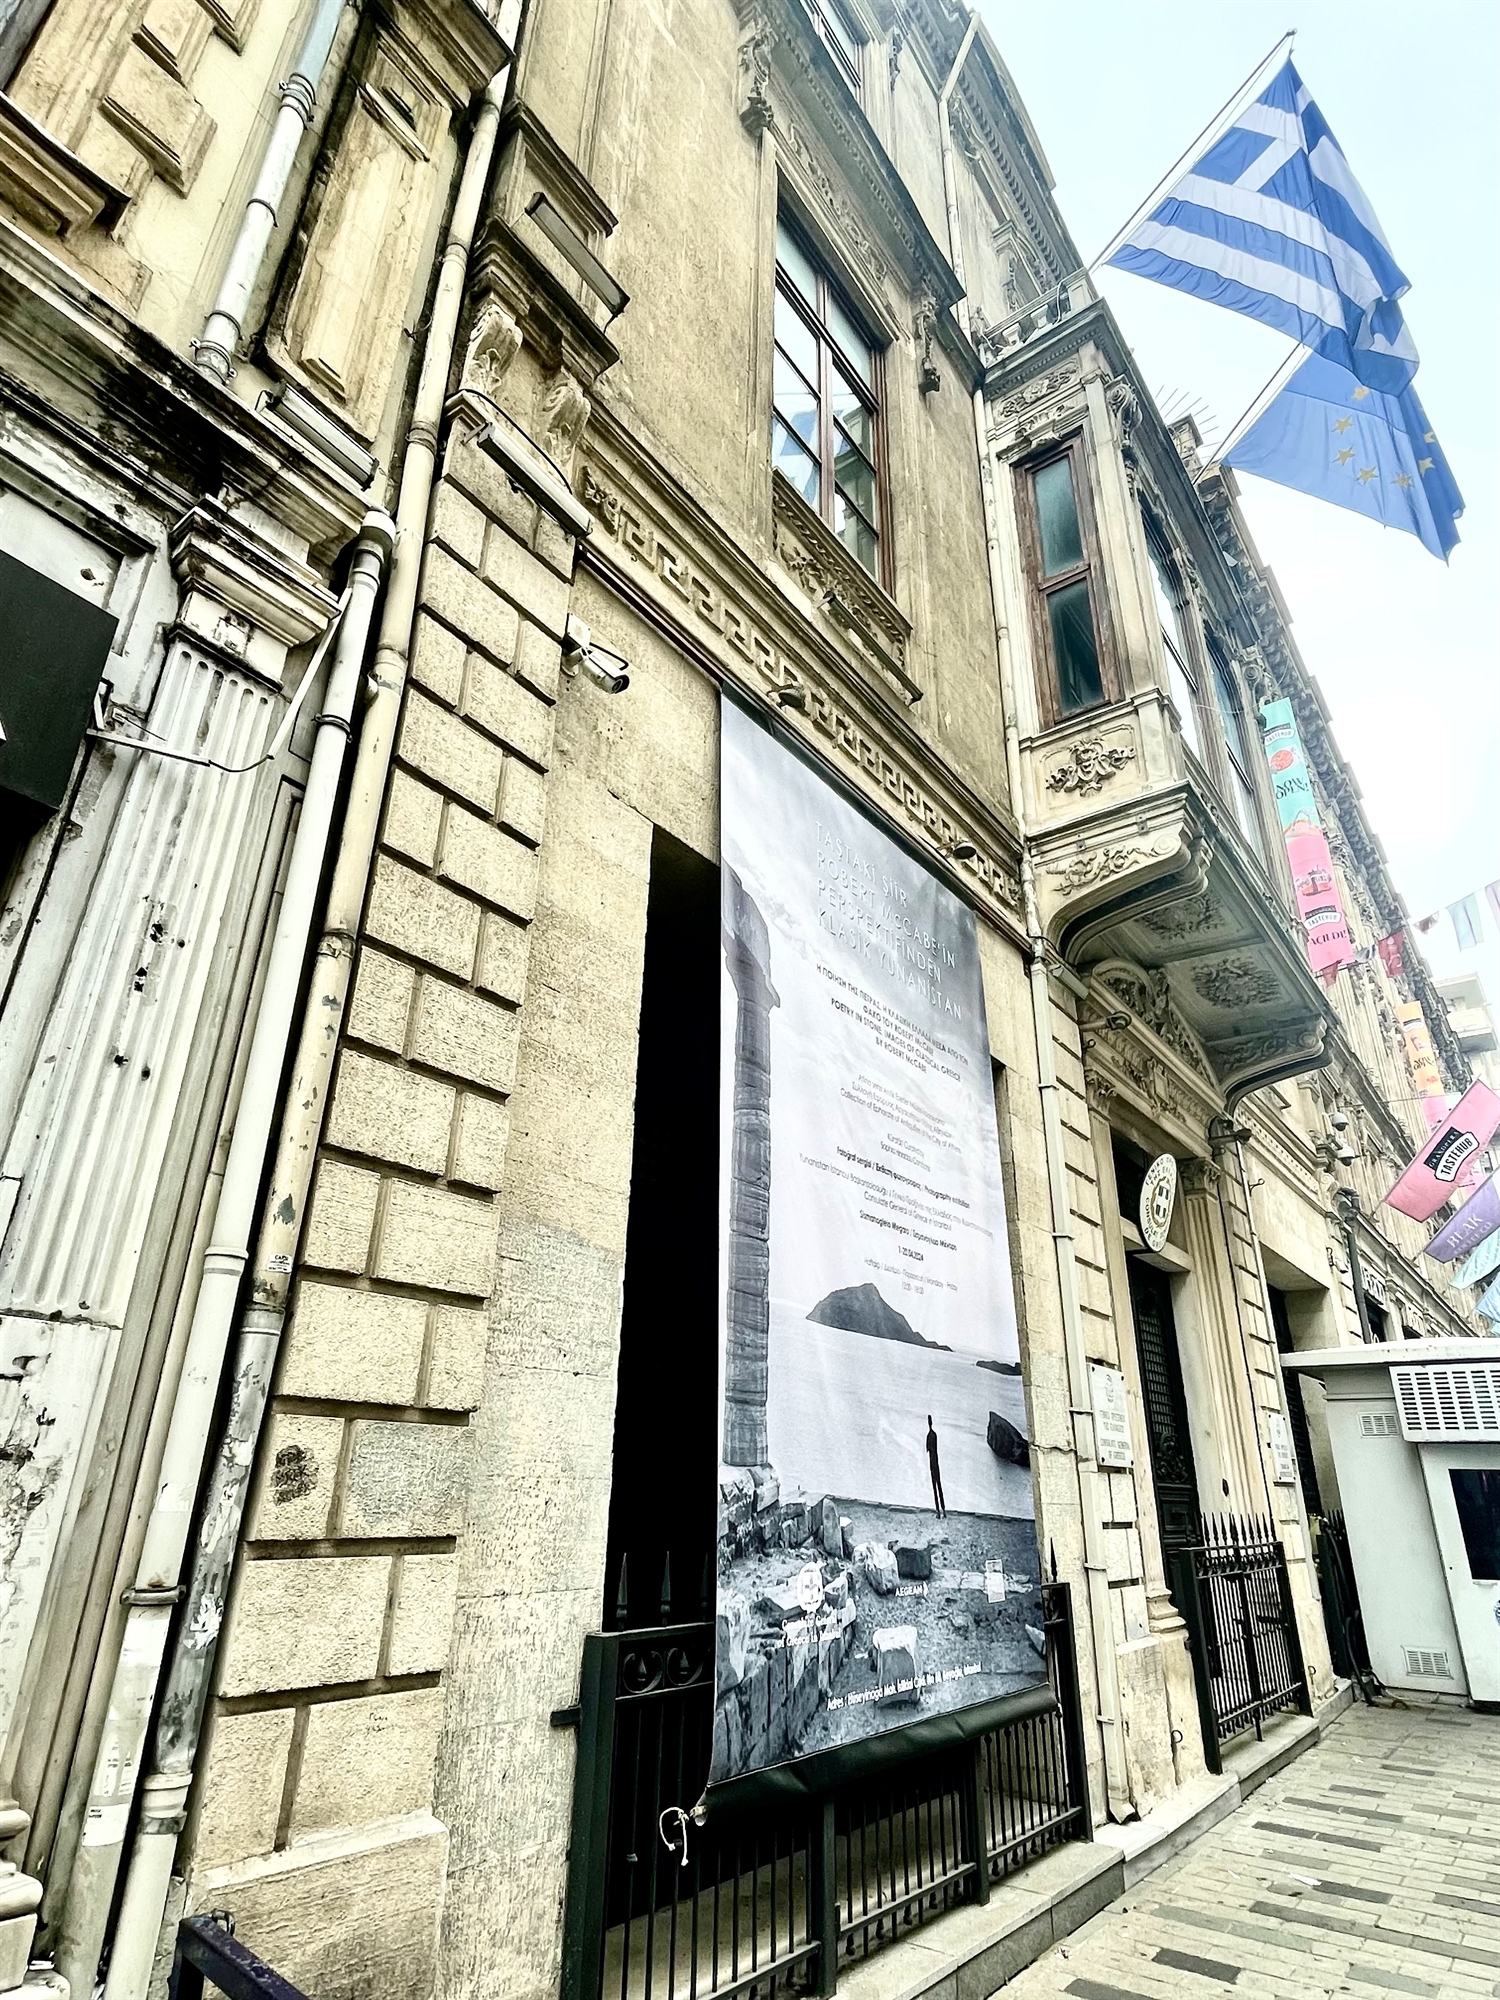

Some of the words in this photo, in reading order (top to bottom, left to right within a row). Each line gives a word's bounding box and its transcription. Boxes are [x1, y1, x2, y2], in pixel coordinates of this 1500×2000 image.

[815, 820, 876, 884] TAŞTAKİ
[882, 873, 907, 909] ŞİİR
[817, 848, 875, 911] ROBERT
[818, 878, 942, 984] PERSPEKTİFİNDEN
[818, 905, 871, 960] KLASİK
[878, 948, 962, 1022] YUNANİSTAN
[831, 997, 853, 1018] POETRY
[1440, 1137, 1474, 1176] TASTEHUB
[895, 1584, 922, 1597] AEGEAN
